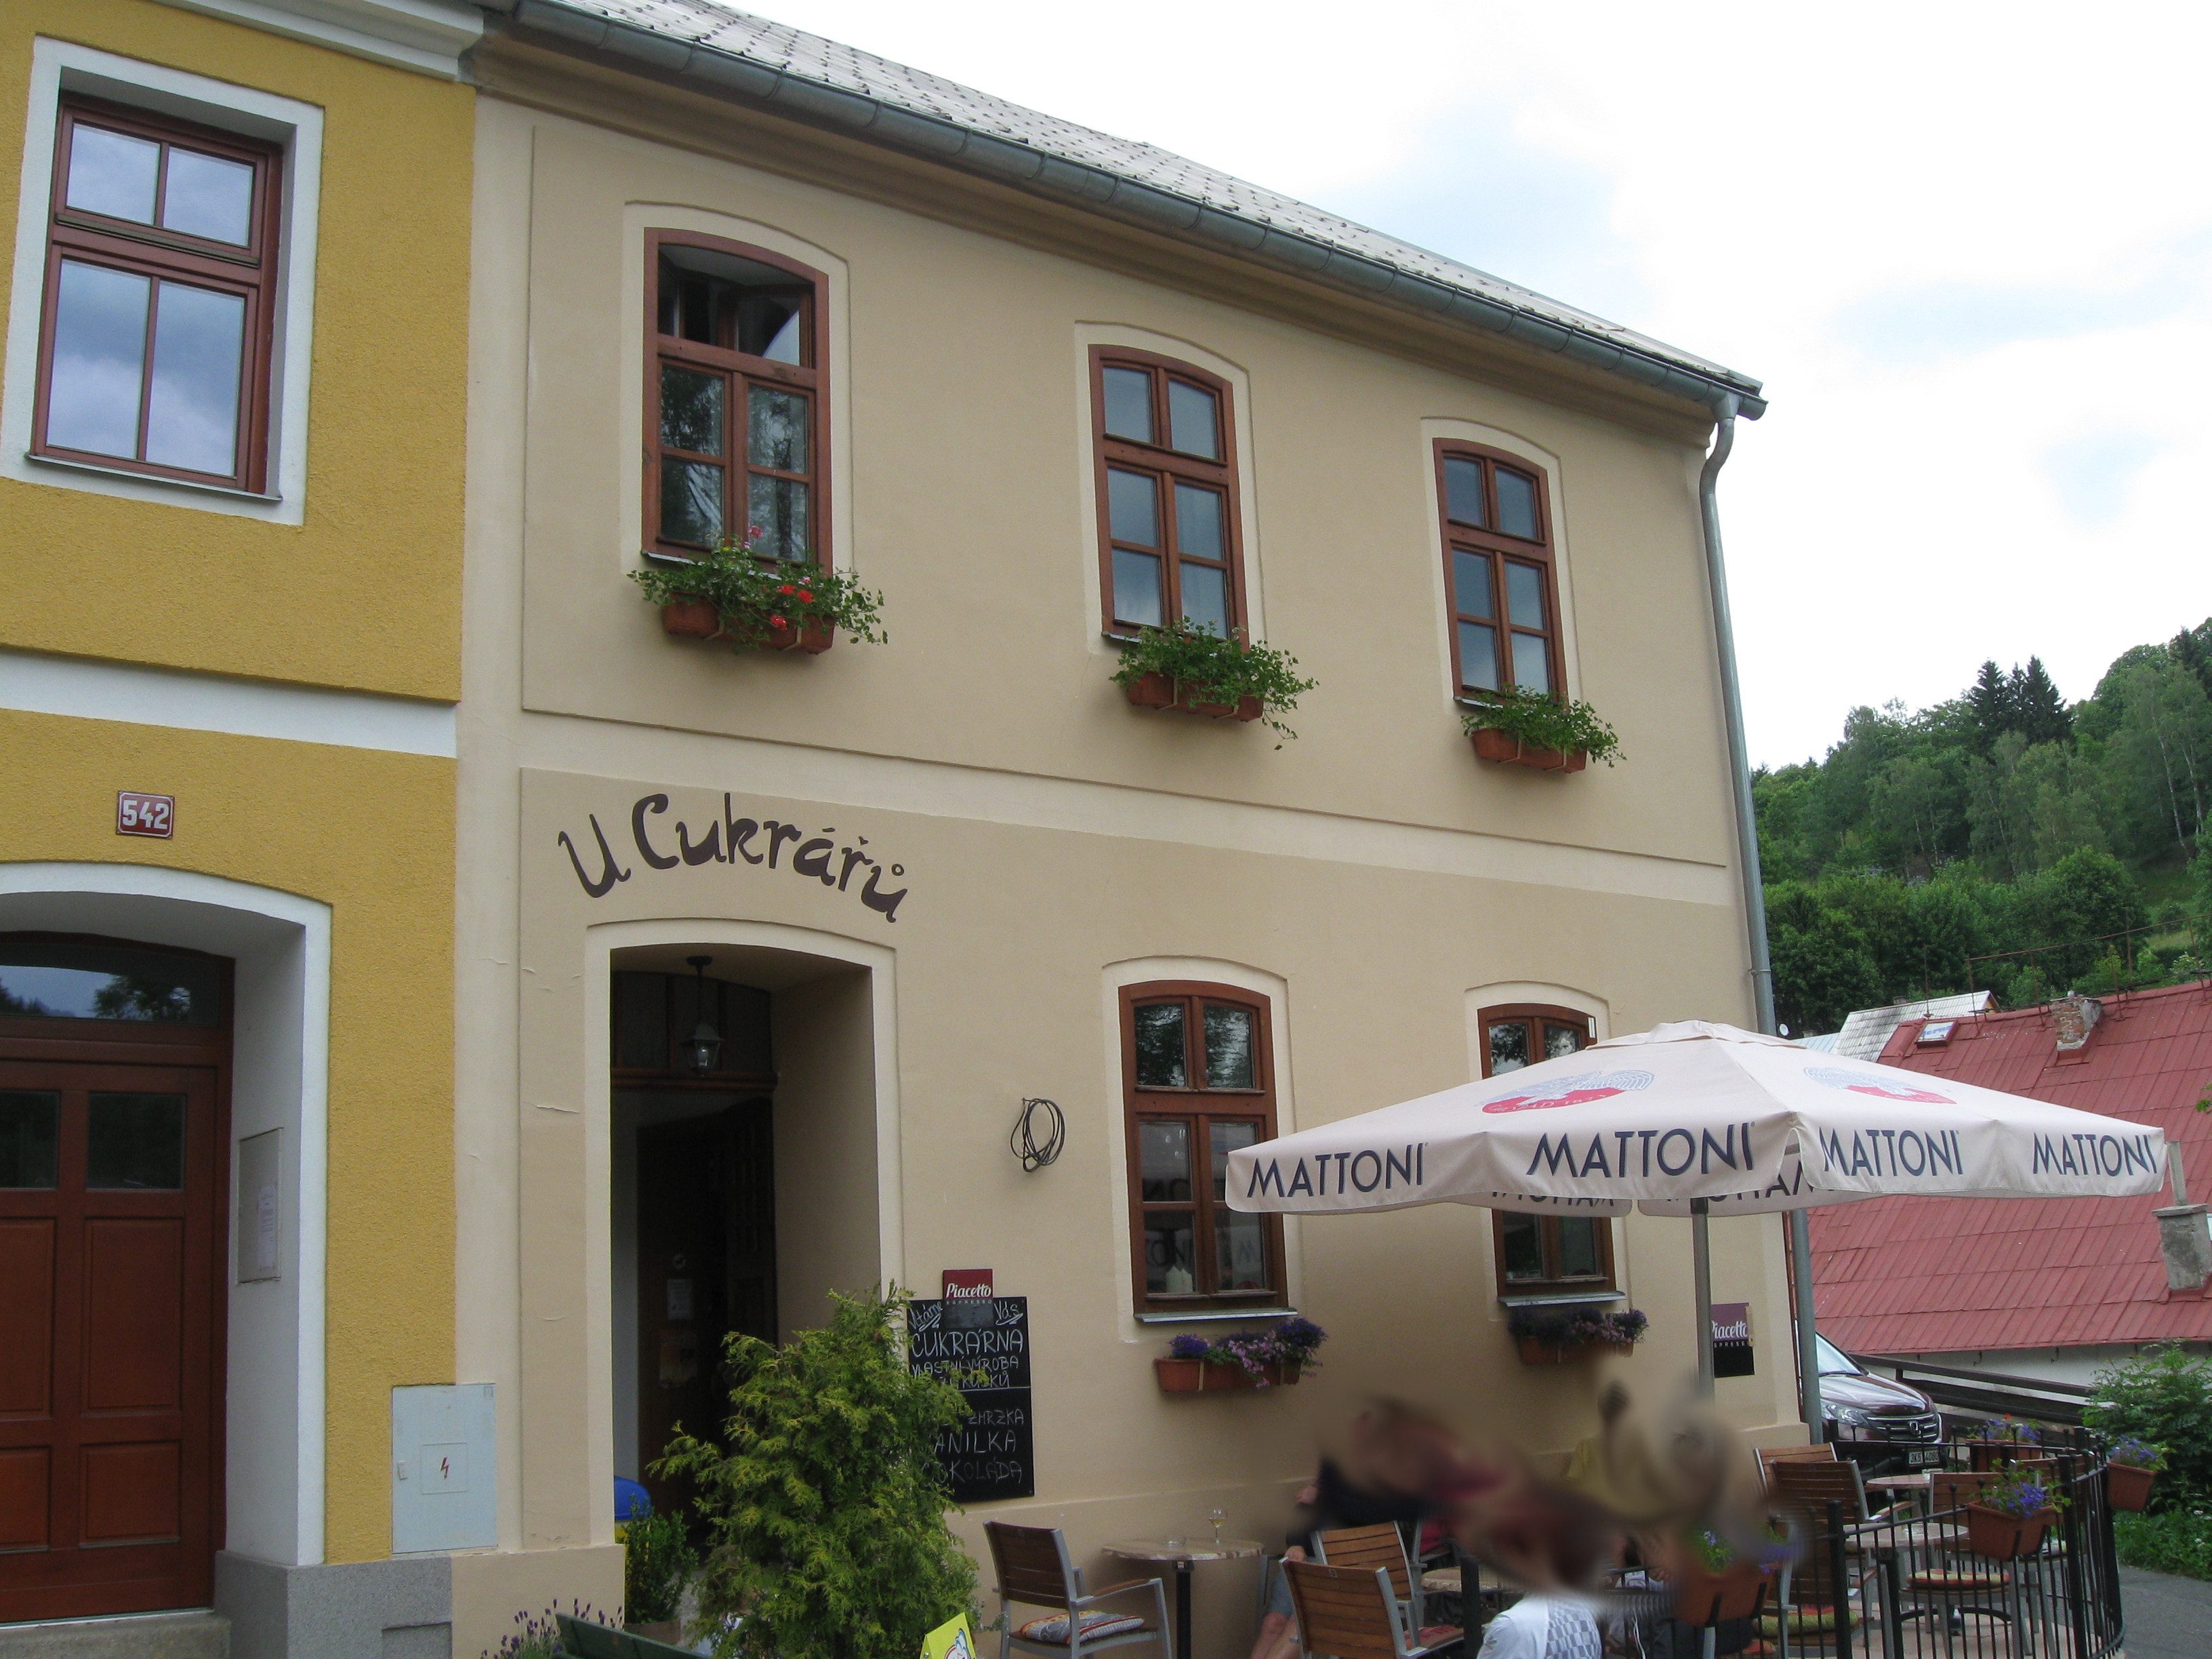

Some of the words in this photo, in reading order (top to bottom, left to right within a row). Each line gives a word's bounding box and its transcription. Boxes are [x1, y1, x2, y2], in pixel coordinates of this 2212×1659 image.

[122, 800, 169, 830] 542
[558, 813, 631, 898] U
[632, 792, 908, 923] Cukrářů
[1525, 1122, 1754, 1179] MATTONI
[1819, 1126, 1964, 1177] MATTONI
[2032, 1132, 2158, 1176] MATTONI
[1247, 1142, 1424, 1198] MATTONI
[945, 1283, 992, 1298] Piacetto
[994, 1300, 1020, 1320] Vás
[912, 1328, 1023, 1358] CUKRÁRNA
[966, 1355, 1019, 1373] VÝROBA
[929, 1430, 1017, 1454] ANILKA
